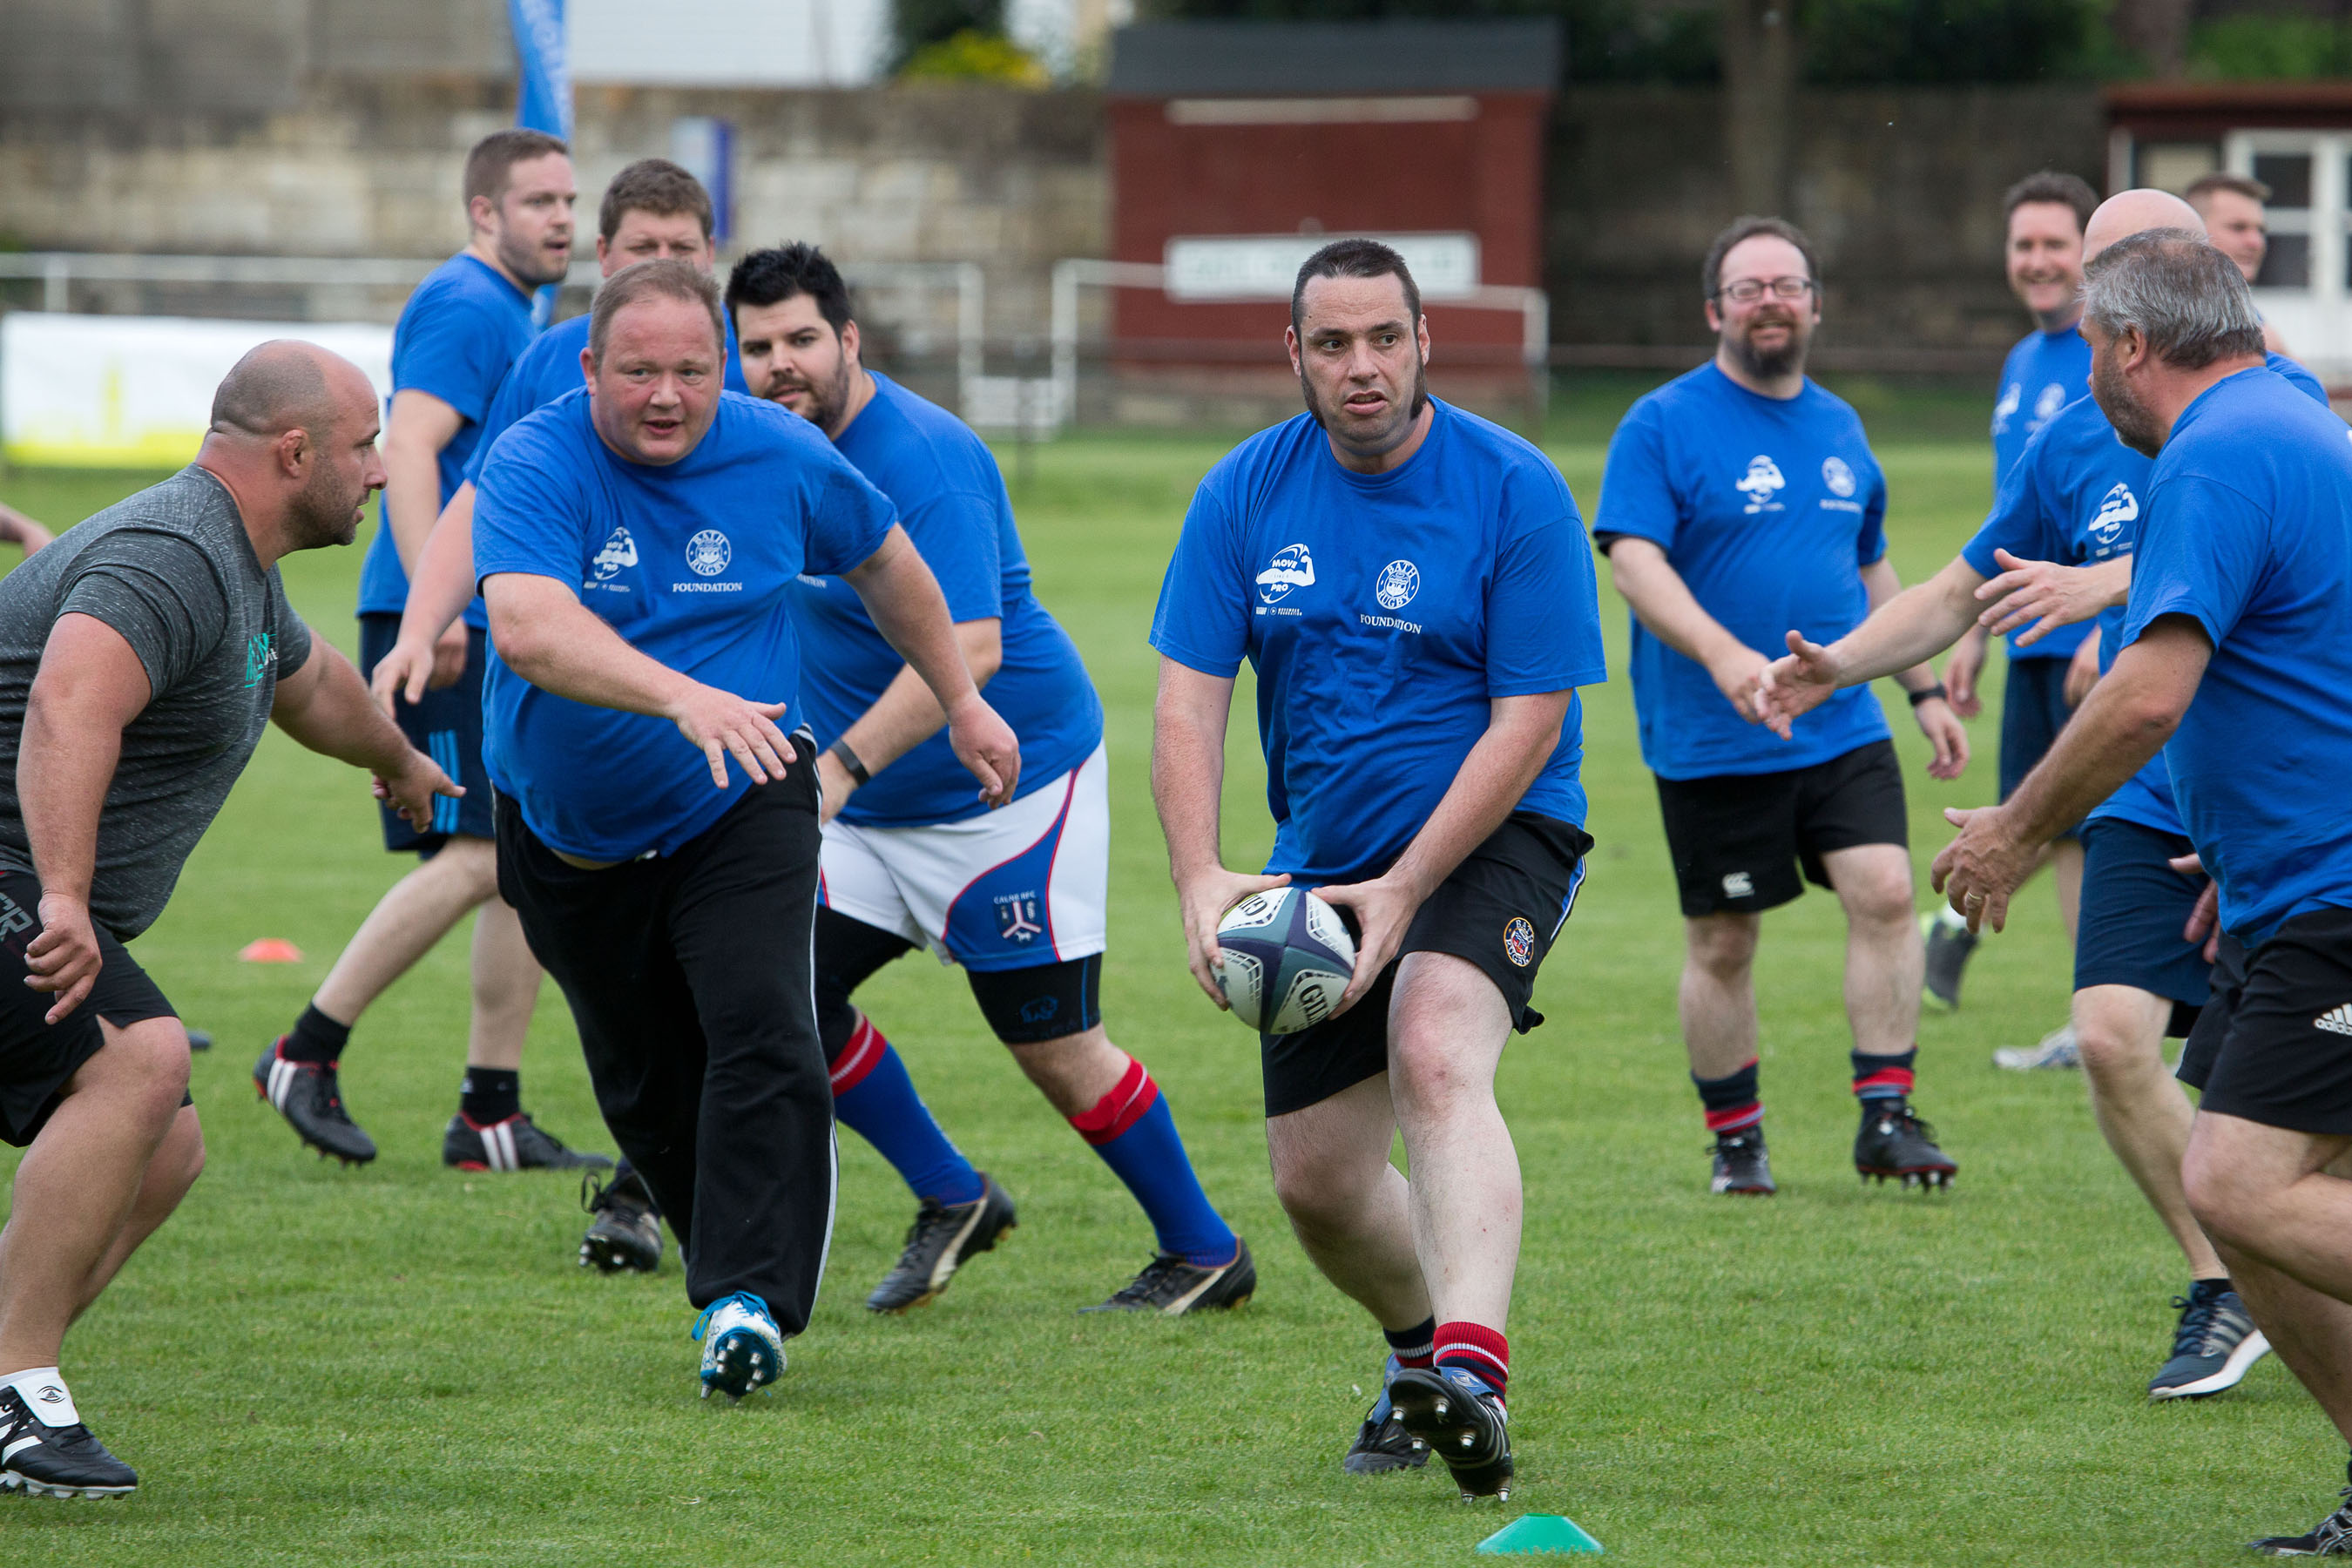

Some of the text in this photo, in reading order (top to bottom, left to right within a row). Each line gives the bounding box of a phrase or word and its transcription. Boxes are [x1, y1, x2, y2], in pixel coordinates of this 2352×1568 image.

[693, 531, 725, 545] BATH
[690, 558, 726, 575] RUGBY
[1272, 558, 1298, 569] MOVE
[1387, 562, 1417, 578] BATH
[672, 582, 743, 592] FOUNDATION
[1270, 583, 1289, 592] PRO
[1378, 591, 1410, 608] RUGBY
[1360, 613, 1423, 635] FOUNDATION
